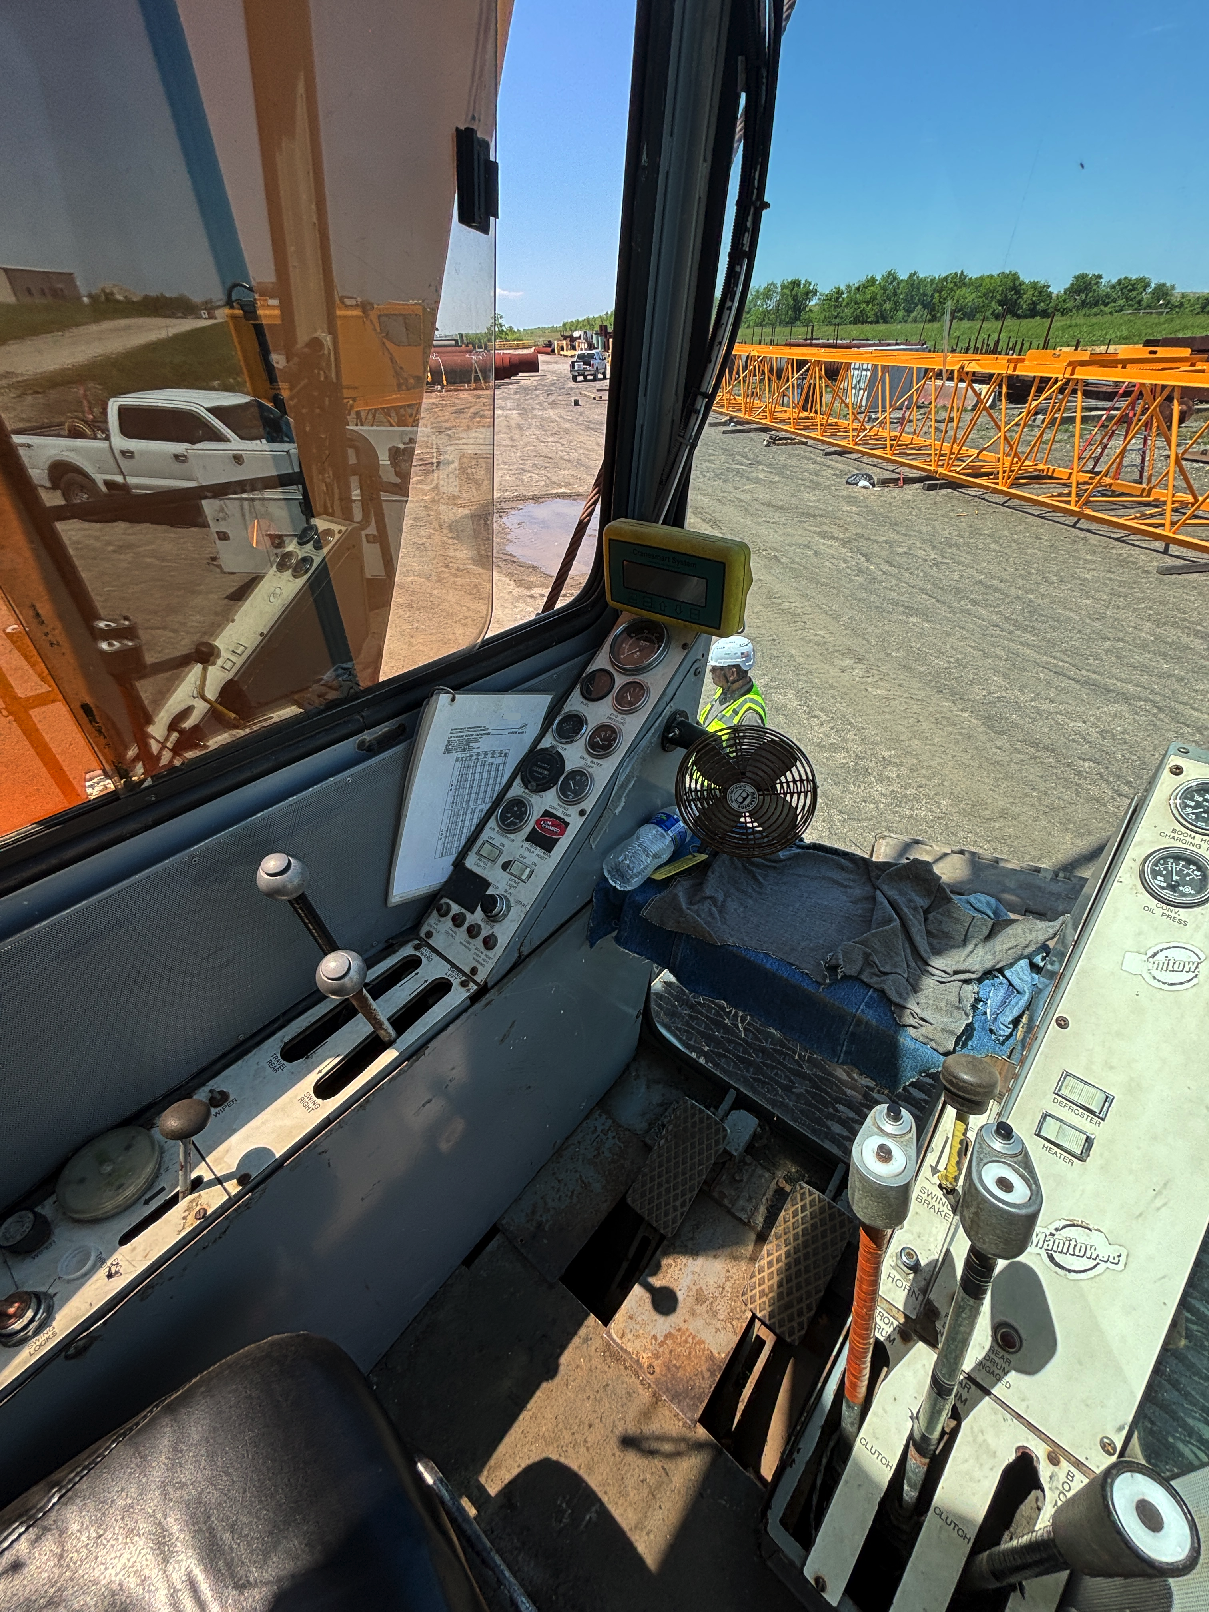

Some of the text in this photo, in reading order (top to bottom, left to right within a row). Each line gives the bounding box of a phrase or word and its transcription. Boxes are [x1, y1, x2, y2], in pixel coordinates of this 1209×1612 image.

[632, 548, 697, 569] Cranesmart System
[1159, 831, 1202, 850] CHARGING
[1170, 827, 1196, 841] BOOM
[1142, 905, 1189, 927] OIL PRESS
[1155, 902, 1181, 917] CONV.
[266, 1060, 278, 1074] REAR
[271, 1053, 287, 1072] TRAVEL
[213, 1098, 238, 1119] WIPER
[298, 1096, 315, 1114] RIGHT
[303, 1091, 321, 1110] SWING
[1052, 1096, 1102, 1128] DEFROSTER
[1041, 1143, 1075, 1167] HEATER
[915, 1195, 951, 1223] BRAKE
[919, 1185, 953, 1212] SWING
[886, 1273, 921, 1302] HORN
[27, 1326, 56, 1350] SWING
[876, 1323, 897, 1346] RUM
[983, 1354, 1010, 1377] DRUM
[988, 1346, 1012, 1367] REAR
[975, 1356, 1012, 1390] ENGAGED
[859, 1436, 895, 1472] CLUTCH
[933, 1505, 973, 1545] CLUTCH
